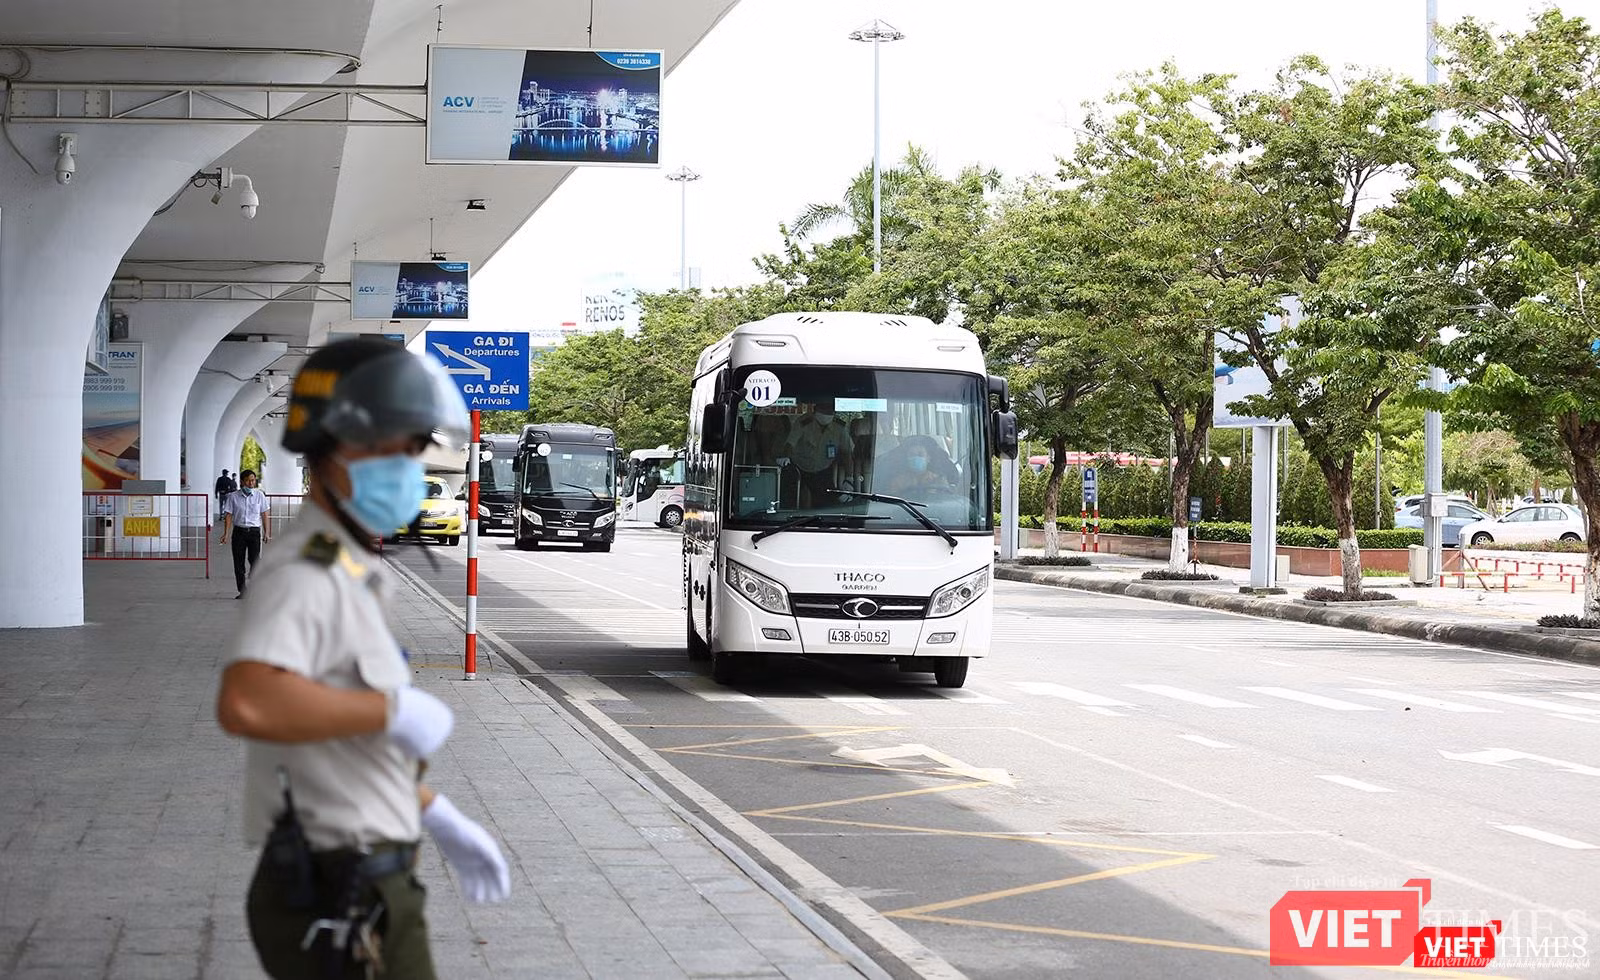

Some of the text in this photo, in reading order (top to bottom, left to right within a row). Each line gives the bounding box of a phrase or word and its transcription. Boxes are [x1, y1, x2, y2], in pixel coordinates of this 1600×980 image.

[443, 96, 475, 107] ACV
[473, 336, 514, 347] GA ĐI
[464, 347, 520, 357] Departures
[463, 379, 520, 394] GA ĐẾN
[752, 386, 770, 401] 01
[471, 396, 511, 405] Arrivals
[126, 520, 158, 533] ANHK
[834, 572, 885, 582] THACO
[831, 630, 888, 642] 43B-050.52
